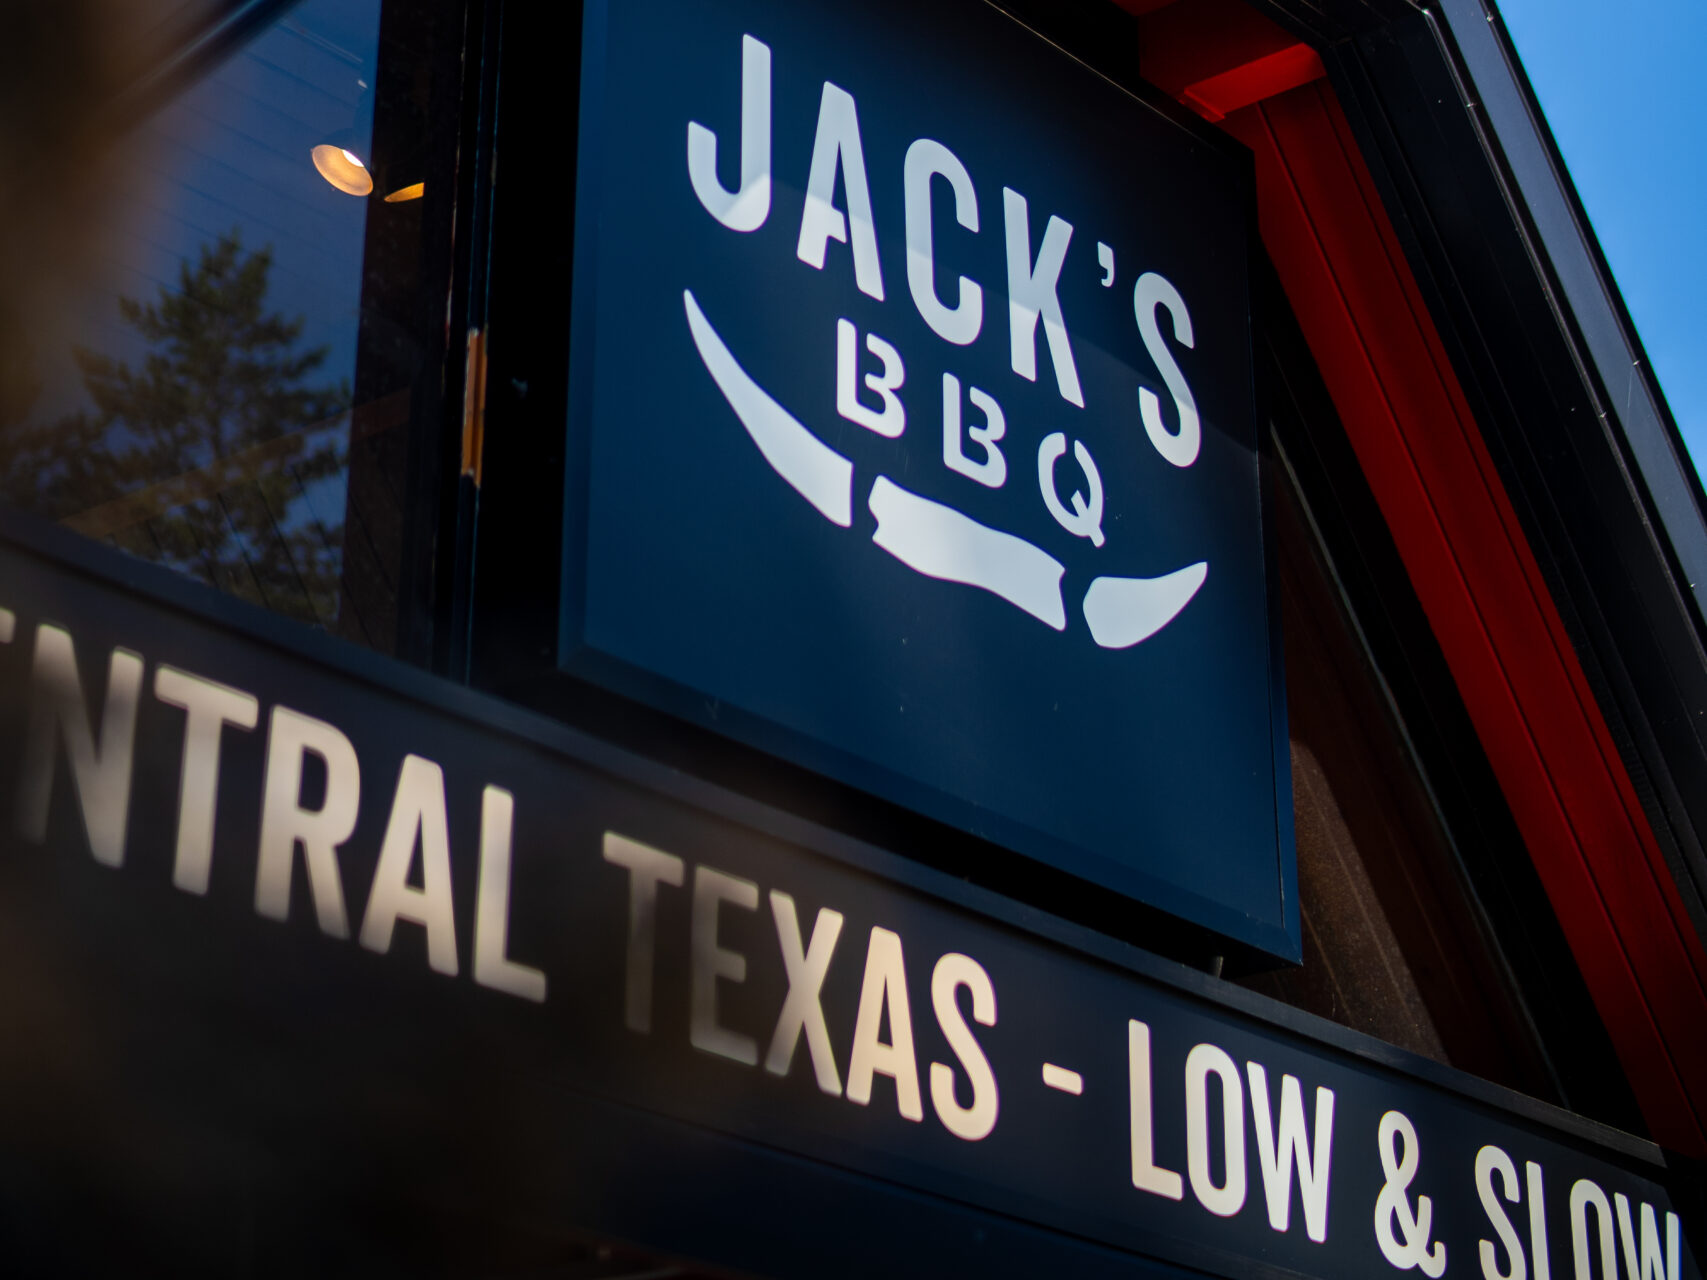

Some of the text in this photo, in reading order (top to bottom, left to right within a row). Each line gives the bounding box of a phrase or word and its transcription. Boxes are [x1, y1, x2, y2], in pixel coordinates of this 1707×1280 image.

[687, 32, 1201, 468] JACK'S
[836, 317, 1106, 548] BBQ
[0, 607, 548, 1004] NTRAL
[602, 829, 999, 1142] TEXAS
[1127, 1018, 1335, 1244] LOW
[1373, 1109, 1447, 1279] &
